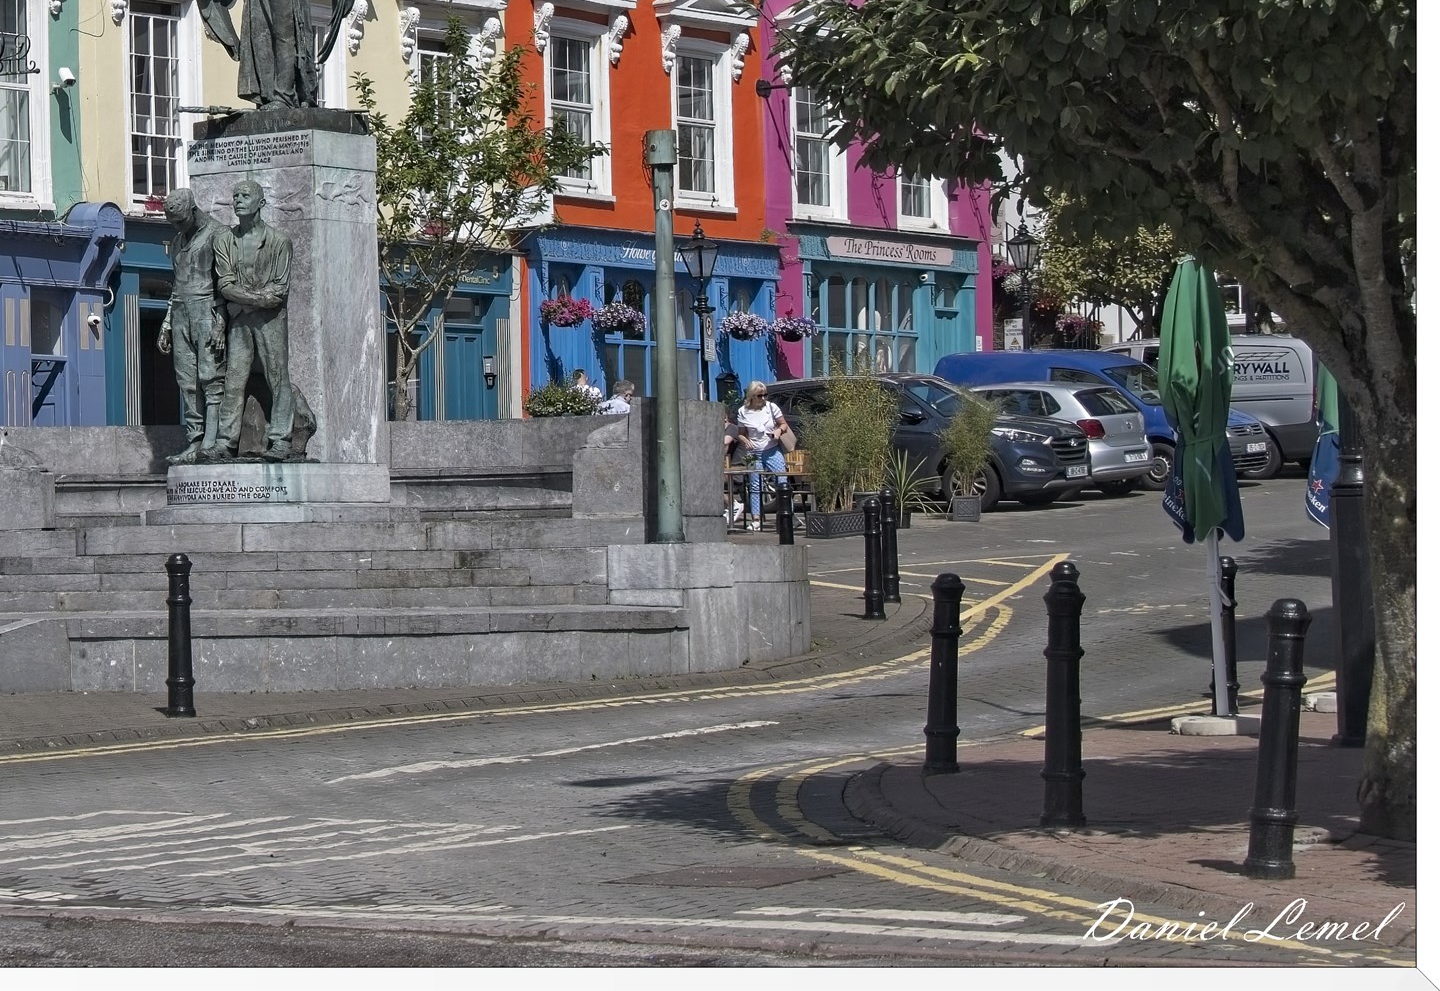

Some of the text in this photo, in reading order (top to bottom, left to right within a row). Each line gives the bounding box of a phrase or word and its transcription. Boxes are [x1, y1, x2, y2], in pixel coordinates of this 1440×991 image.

[210, 140, 235, 149] MEMORY
[244, 138, 255, 146] ALL
[272, 134, 300, 143] PERISHED
[248, 144, 278, 152] LUSITANIA
[257, 149, 290, 158] UNIVERSAL
[227, 159, 252, 167] LASTING
[621, 239, 652, 260] House
[844, 238, 862, 254] The
[906, 244, 937, 262] Rooms
[1233, 362, 1290, 375] RYWALL
